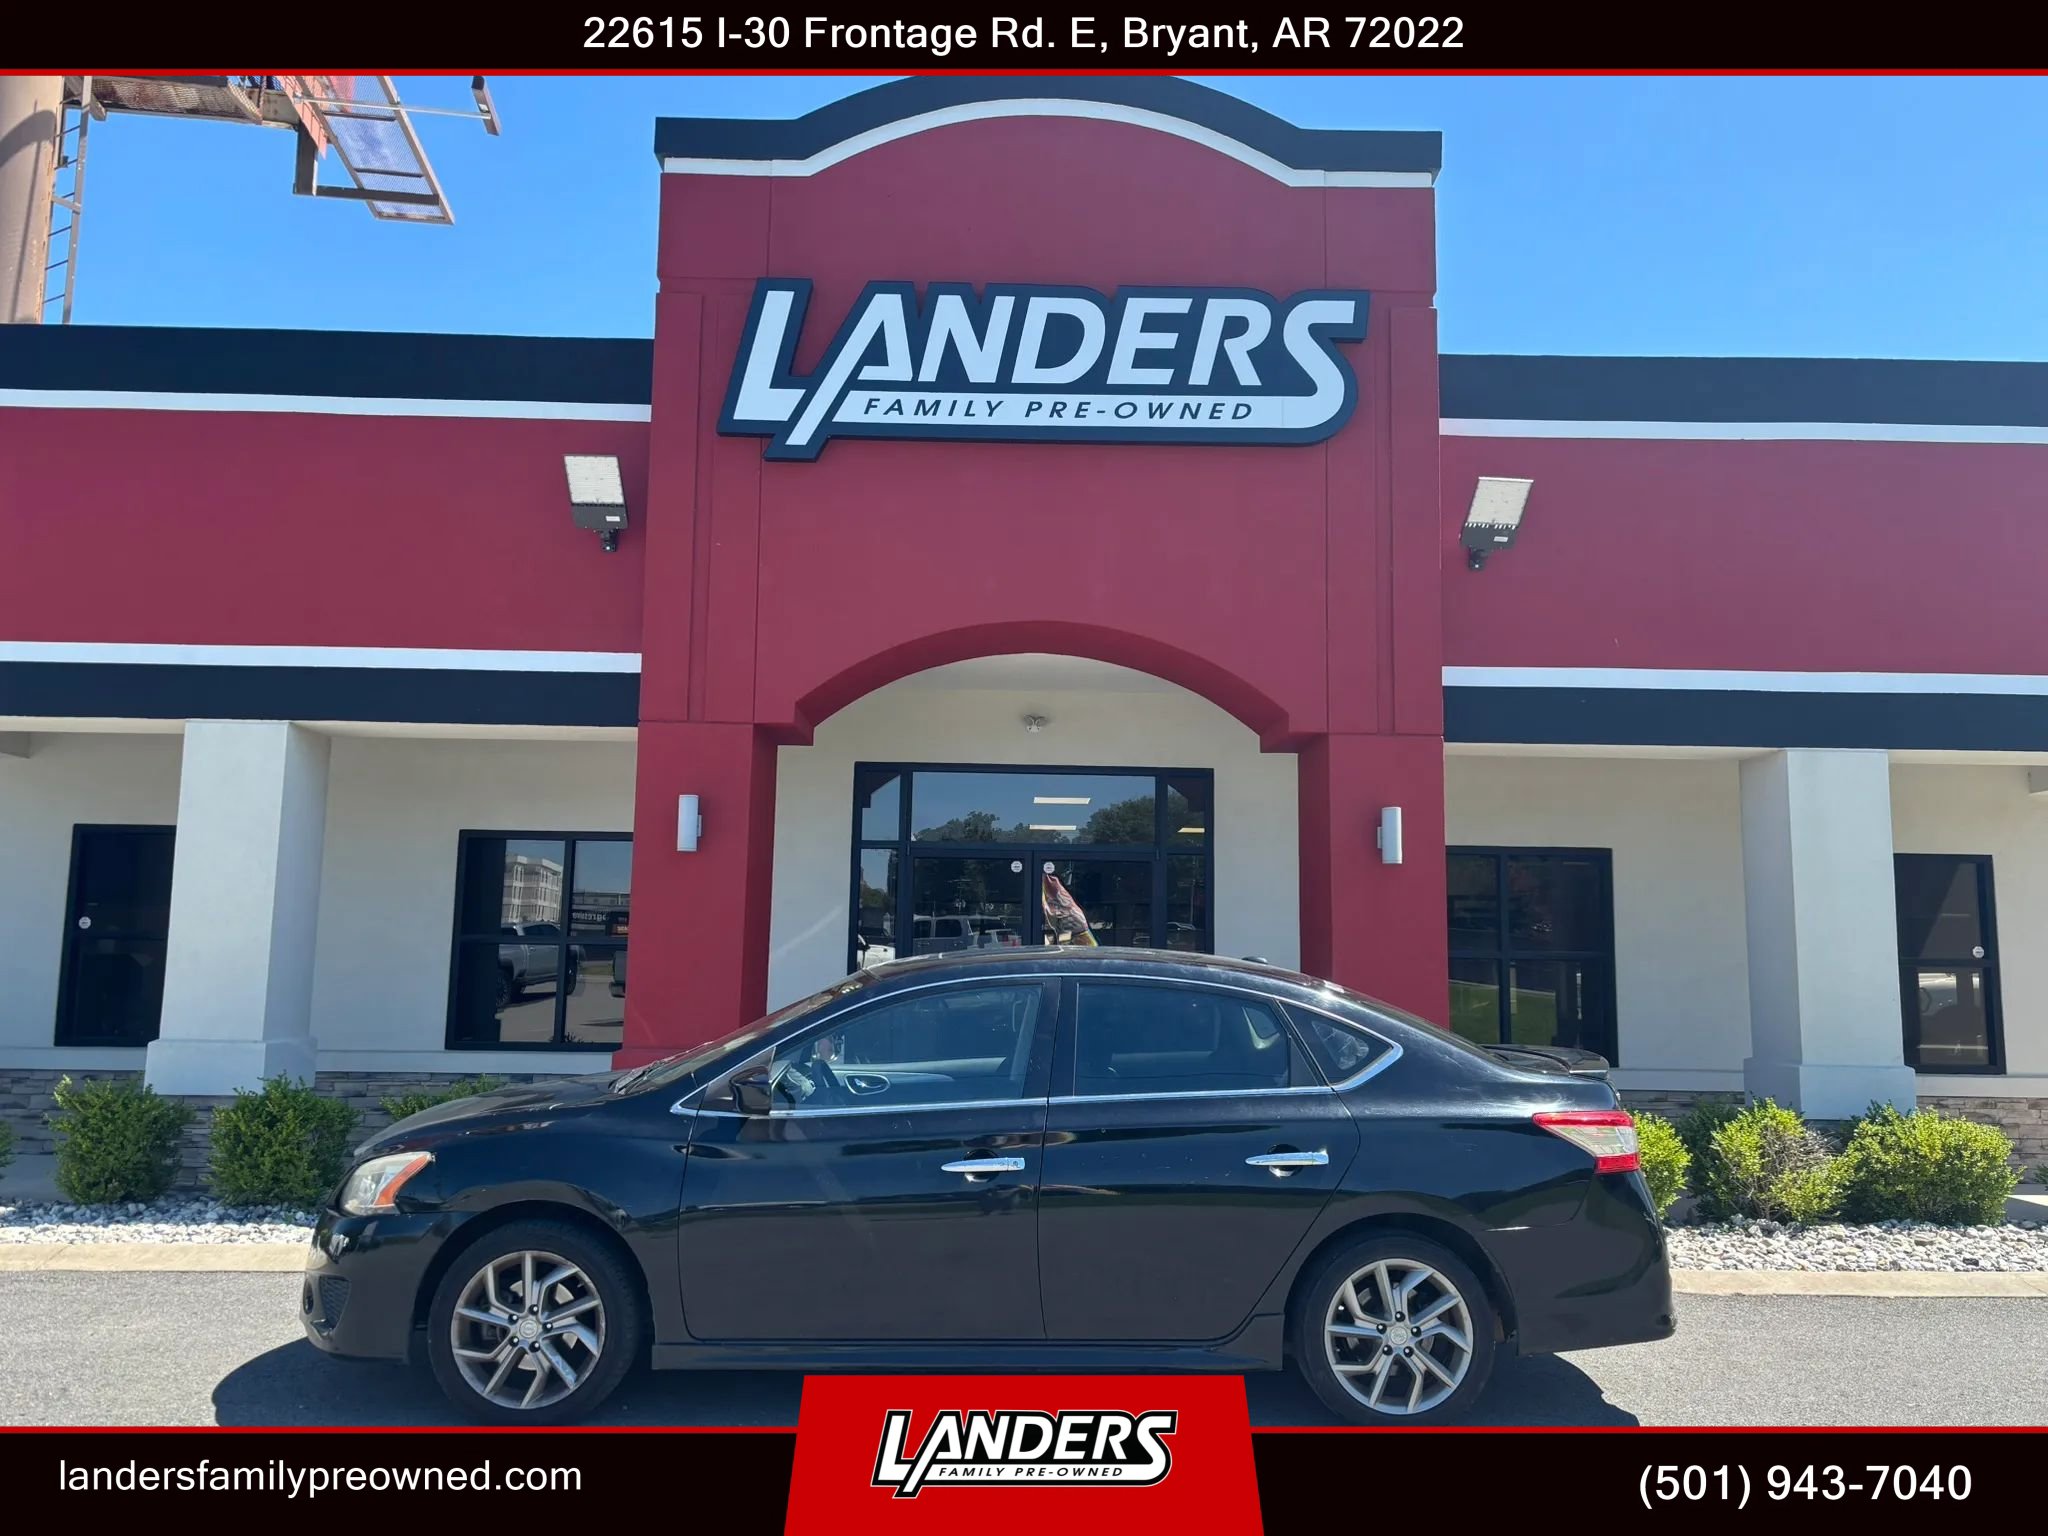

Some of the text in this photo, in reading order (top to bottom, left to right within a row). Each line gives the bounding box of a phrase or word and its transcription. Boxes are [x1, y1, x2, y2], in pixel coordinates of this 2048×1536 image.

[733, 290, 1356, 446] LANDERS
[863, 398, 1253, 420] FAMILY PRE-OWNED
